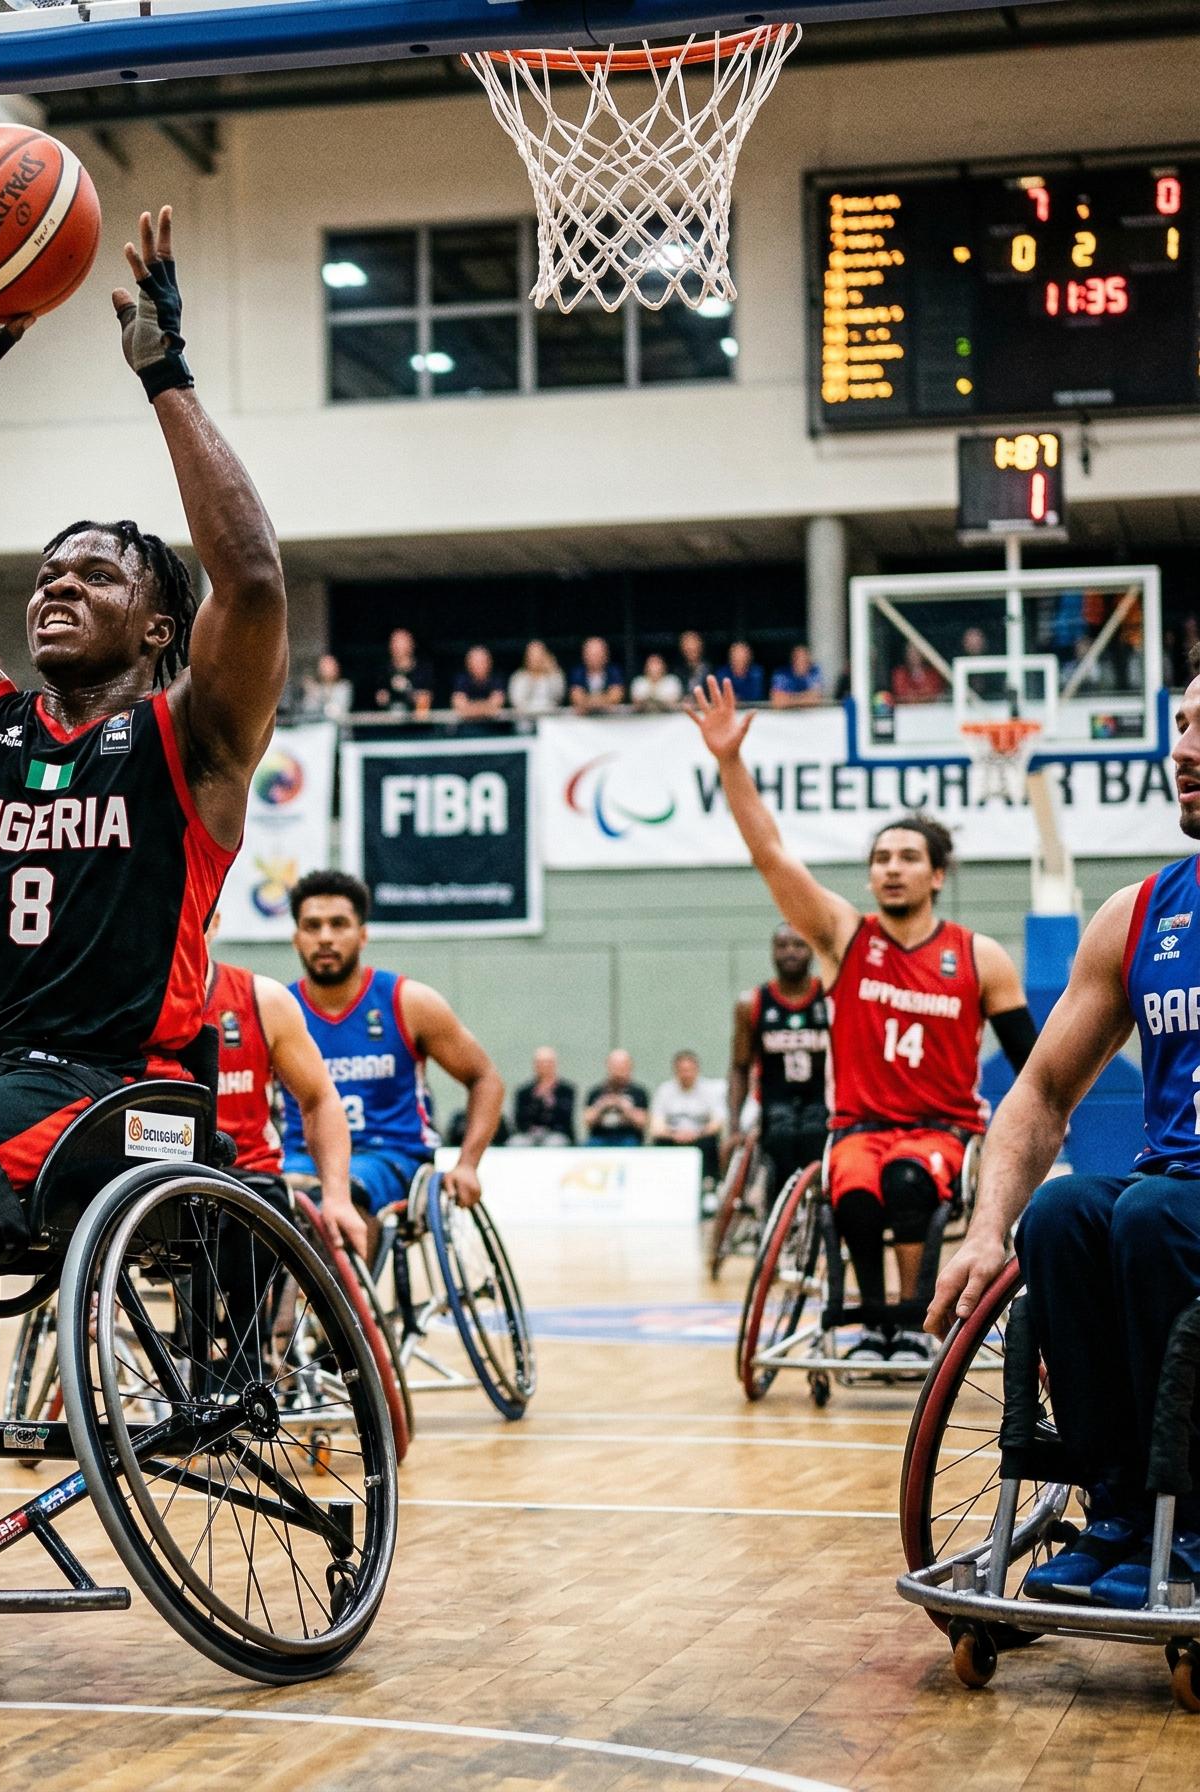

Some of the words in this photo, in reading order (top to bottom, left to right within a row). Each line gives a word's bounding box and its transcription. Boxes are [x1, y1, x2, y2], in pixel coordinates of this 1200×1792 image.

[1156, 177, 1180, 215] 0
[1011, 234, 1037, 272] 0
[1071, 231, 1096, 268] 2
[1166, 226, 1180, 260] 1
[1031, 473, 1045, 520] 1
[381, 771, 508, 838] FIBA
[9, 867, 54, 945] 8
[884, 1018, 924, 1068] 14
